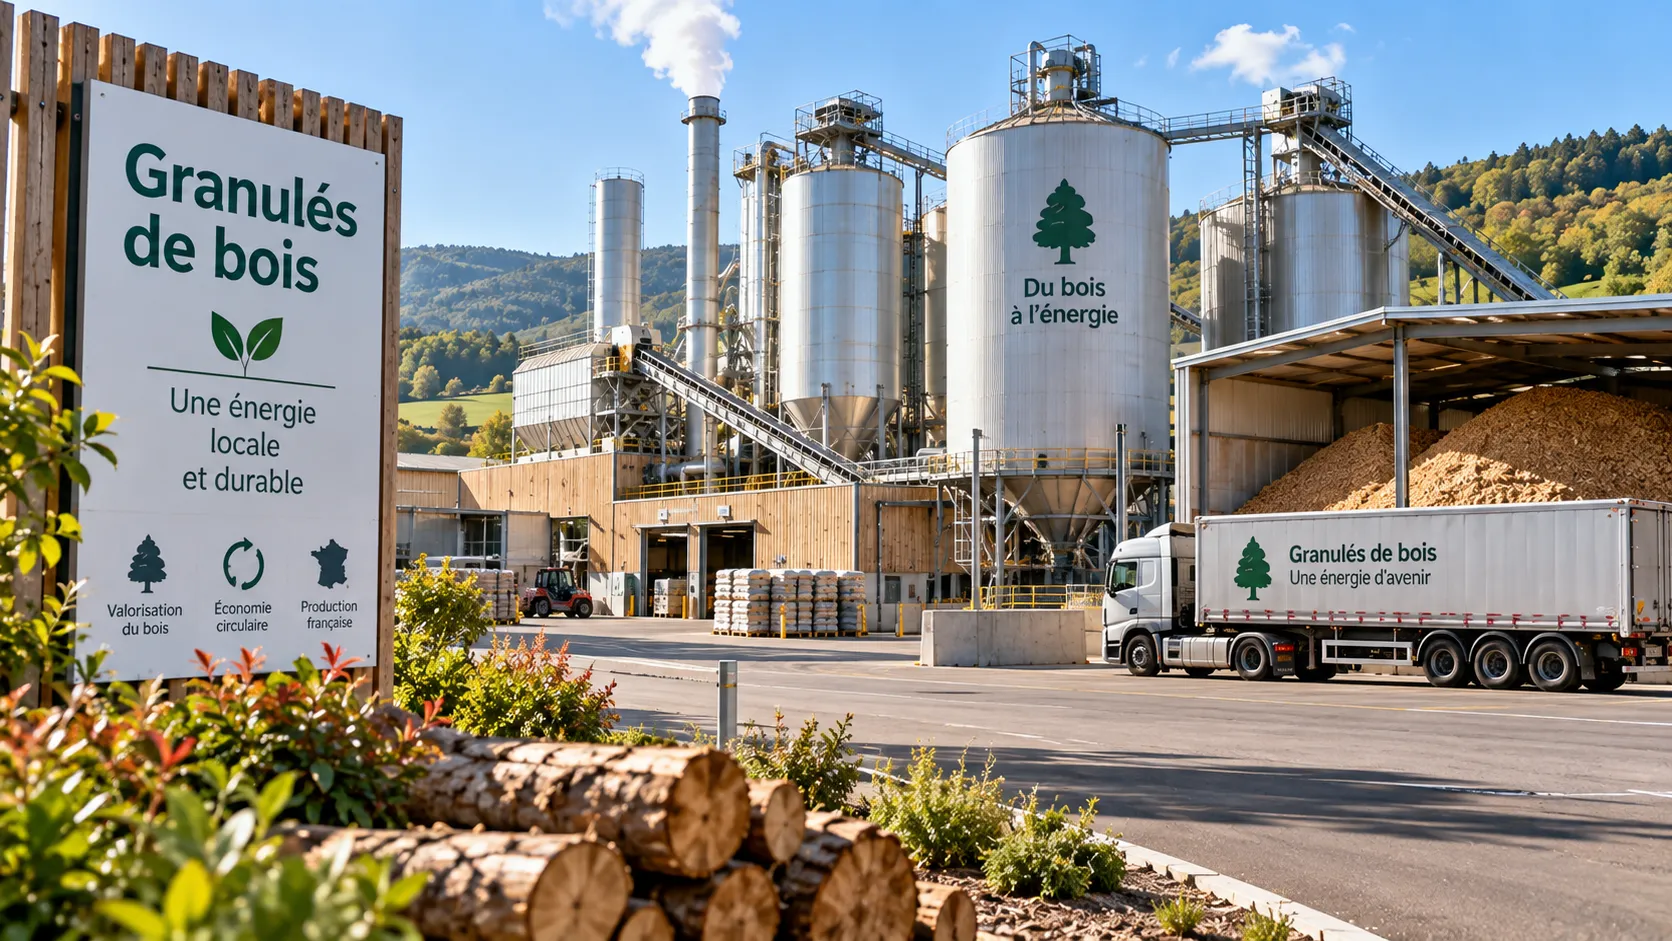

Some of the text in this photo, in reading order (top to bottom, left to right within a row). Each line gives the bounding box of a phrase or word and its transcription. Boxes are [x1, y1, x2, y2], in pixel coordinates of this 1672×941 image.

[125, 143, 358, 238] Granulés
[124, 213, 319, 293] de bois
[1024, 276, 1106, 298] Du bois
[1011, 305, 1022, 325] à
[171, 387, 316, 429] Une énergie
[211, 428, 280, 457] locale
[183, 466, 304, 494] et durable
[1289, 542, 1437, 564] Granulés de bois
[1290, 569, 1431, 588] Une énergie d'avenir
[107, 603, 183, 618] Valorisation
[214, 600, 272, 615] Économie
[301, 600, 358, 613] Production
[122, 622, 169, 635] du bois
[216, 618, 269, 632] circulaire
[307, 616, 353, 631] française
